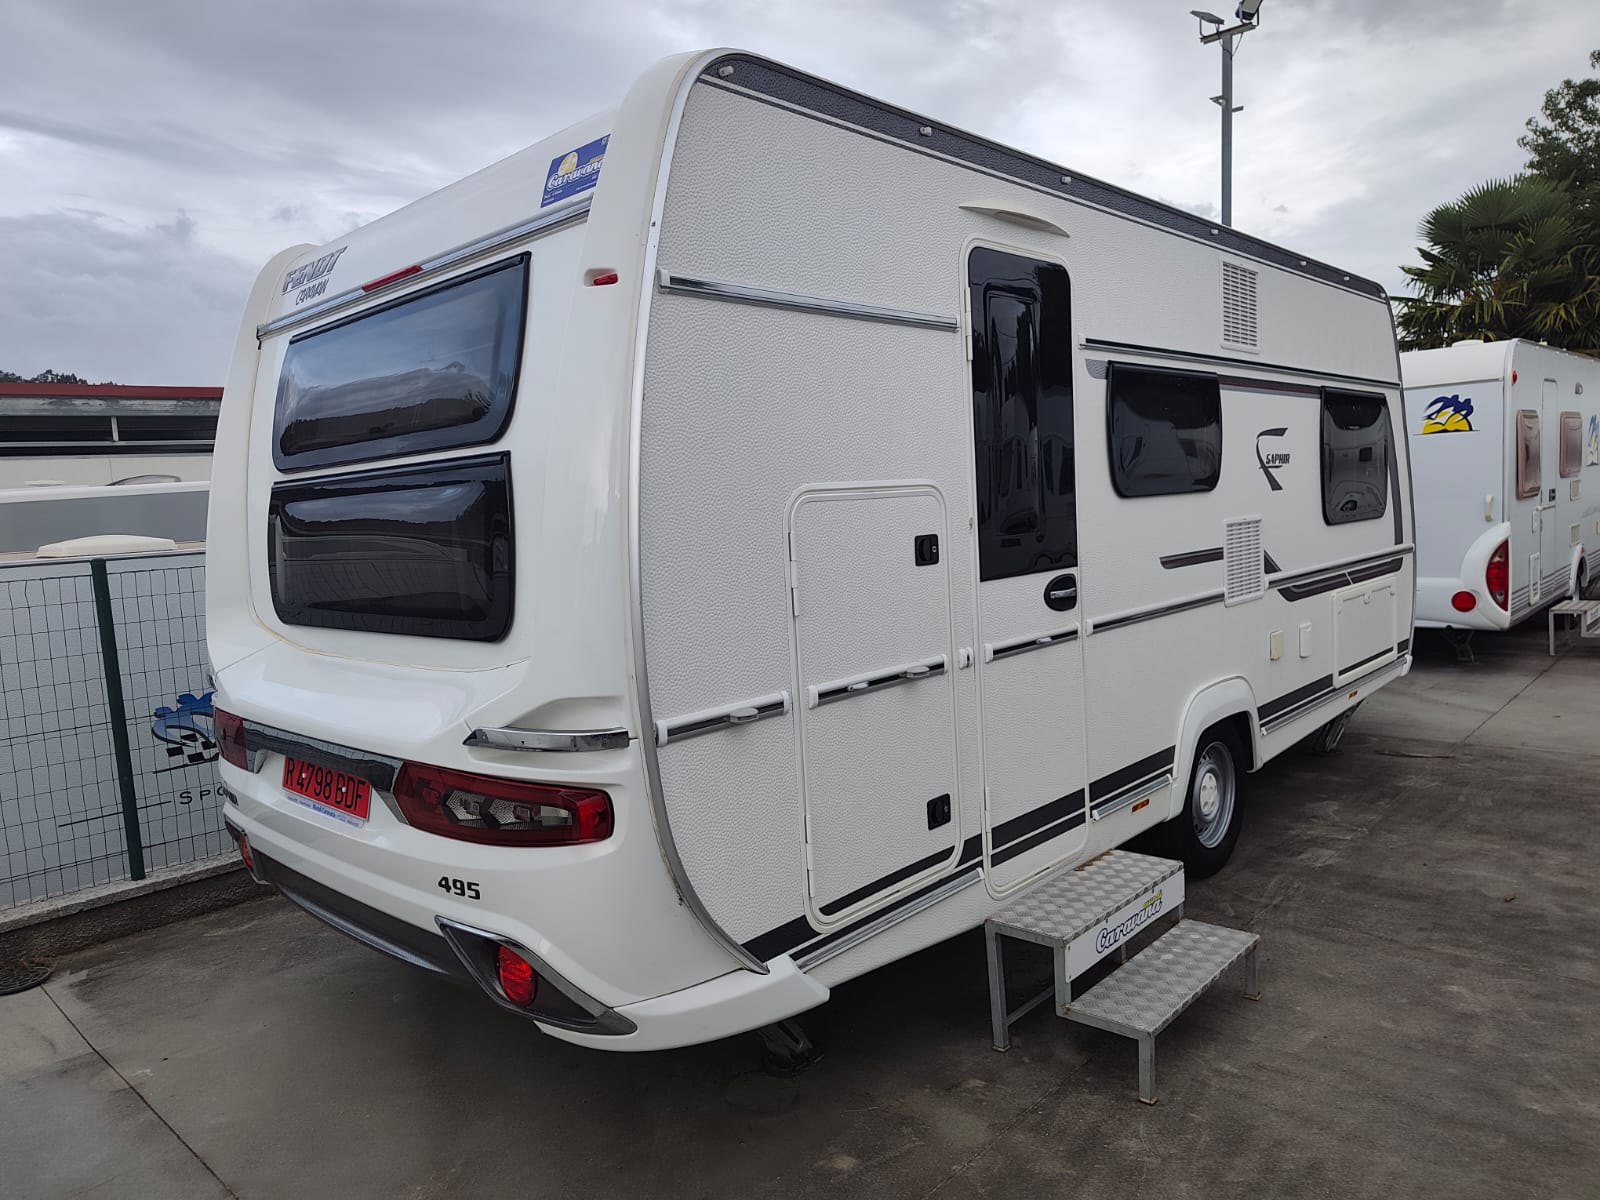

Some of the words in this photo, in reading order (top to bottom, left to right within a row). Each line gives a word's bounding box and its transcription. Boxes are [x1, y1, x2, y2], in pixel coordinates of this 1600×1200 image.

[282, 246, 347, 293] FENDT
[296, 278, 329, 305] CARAVAN
[1266, 453, 1290, 464] SAPHIR
[286, 757, 295, 786] R
[297, 761, 333, 800] 4798
[335, 773, 366, 811] BDF
[438, 876, 480, 900] 495
[1096, 898, 1163, 953] Caravana
